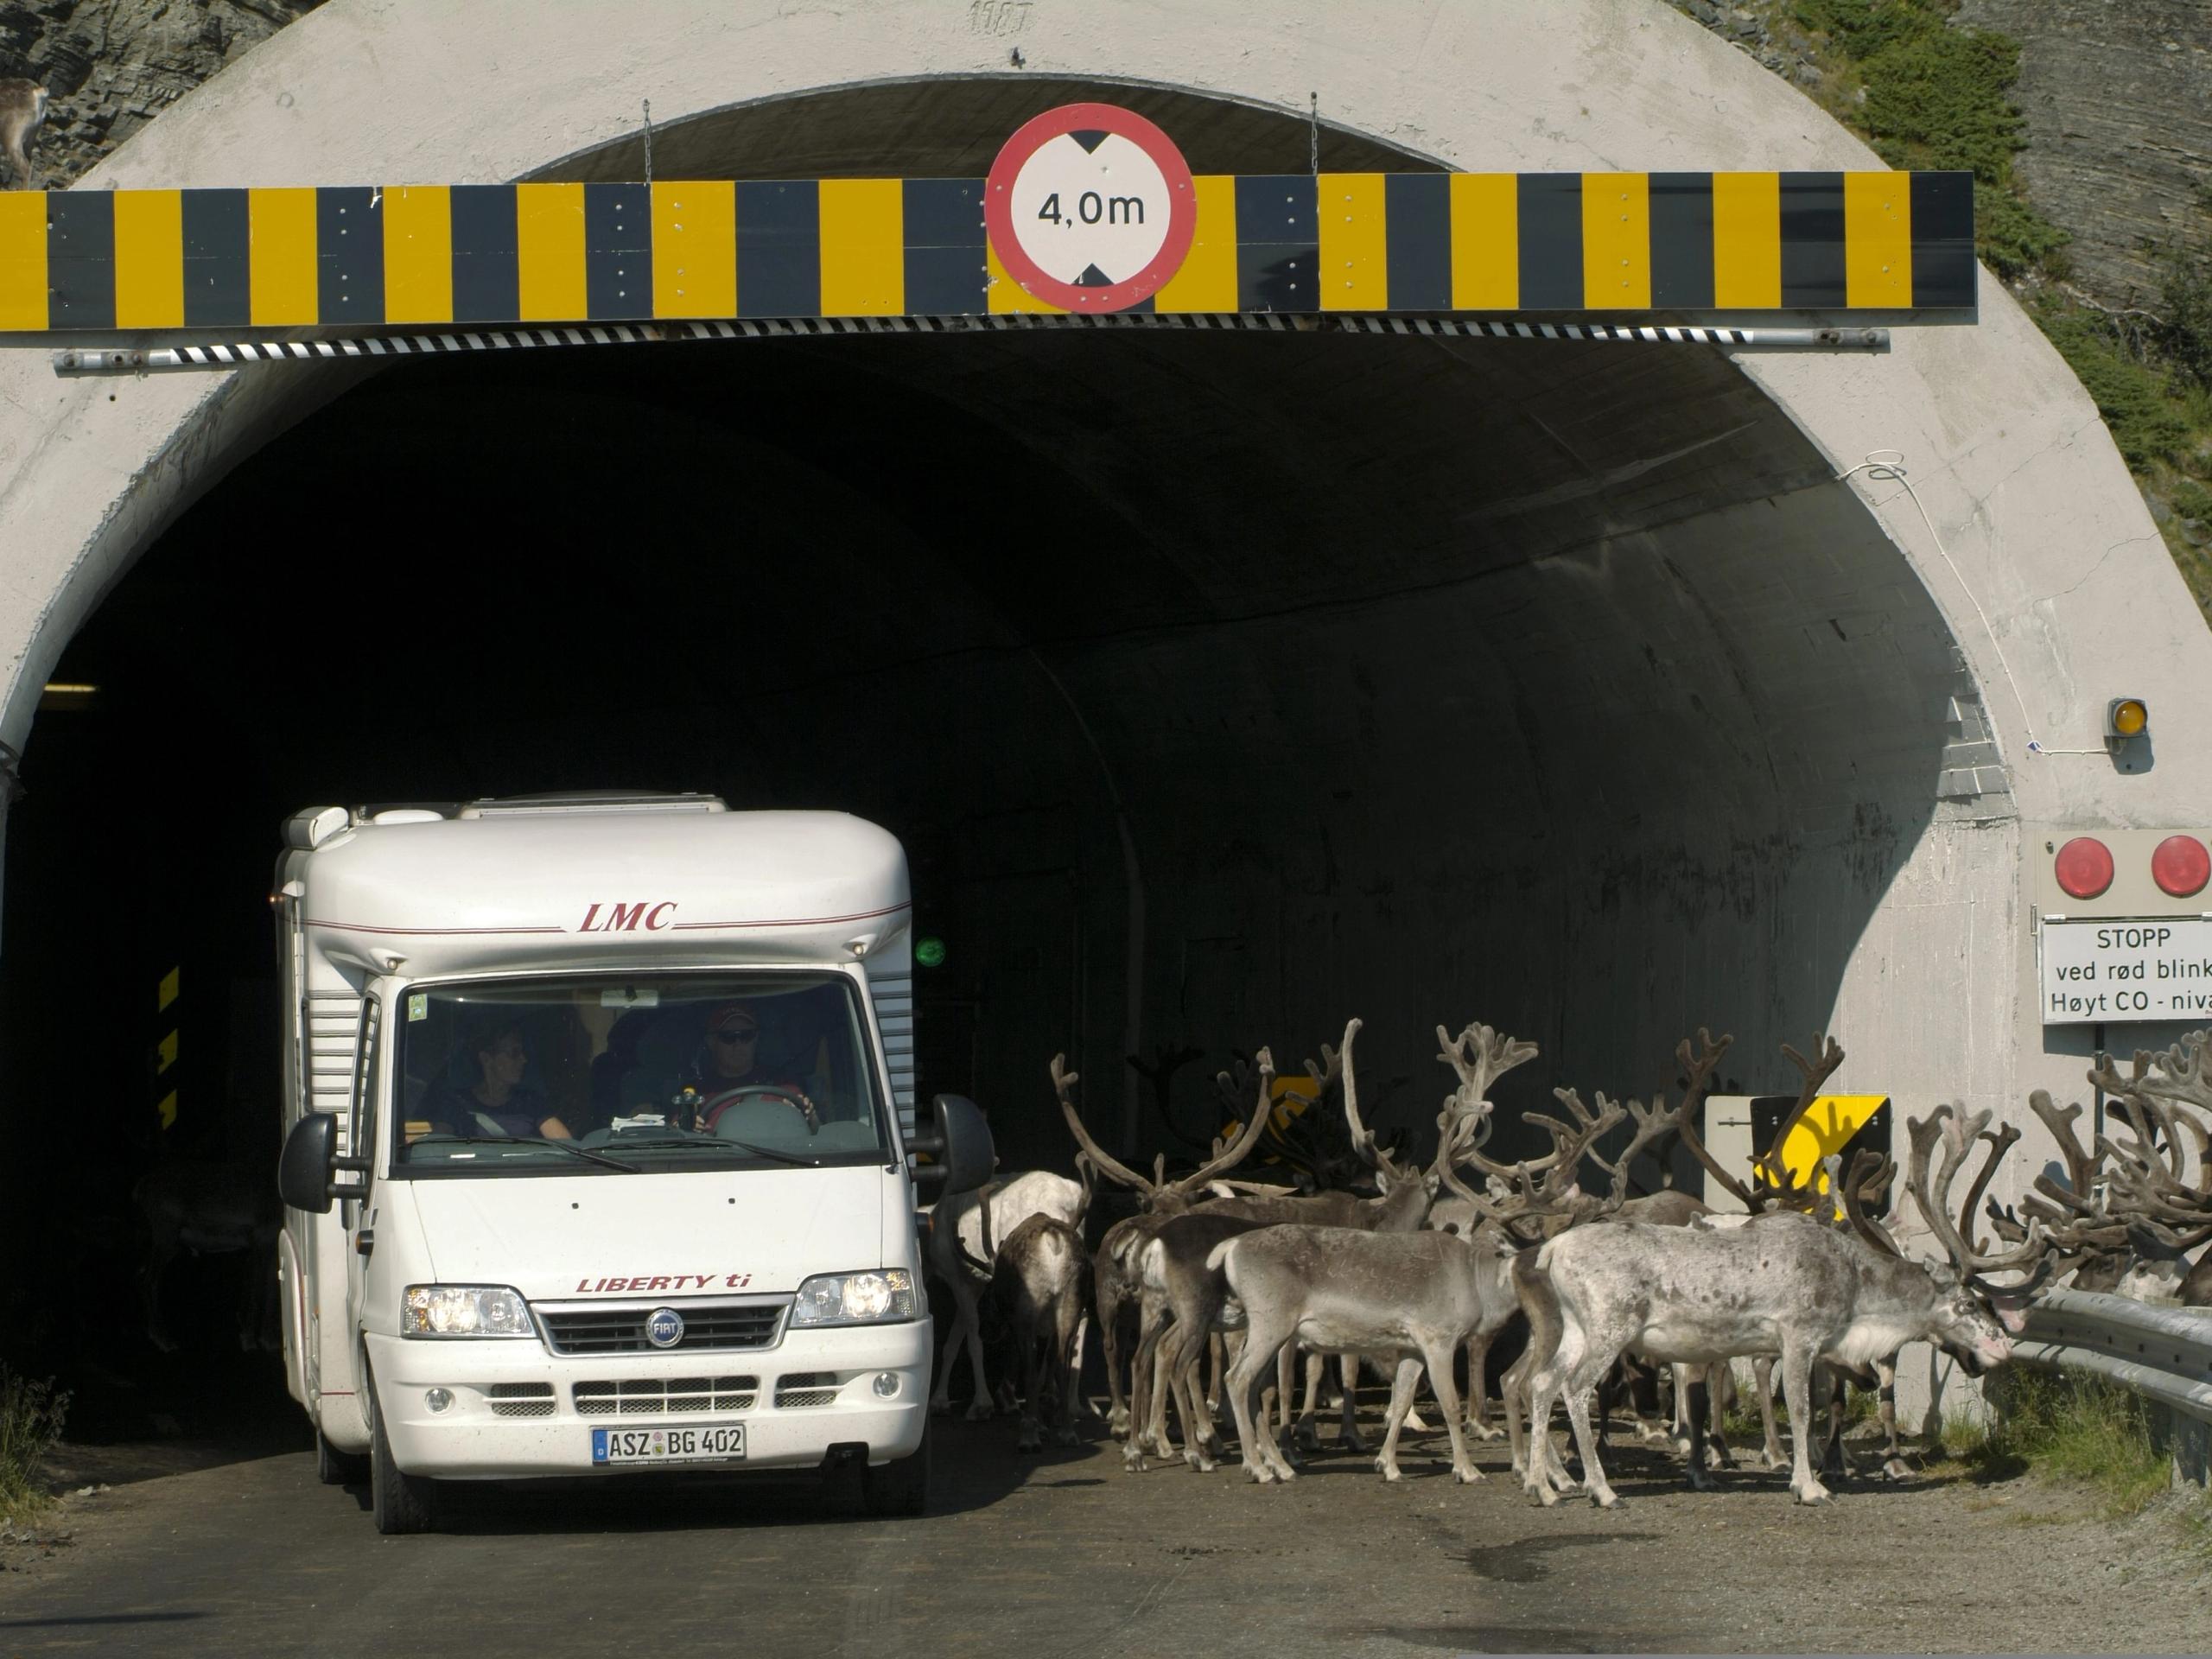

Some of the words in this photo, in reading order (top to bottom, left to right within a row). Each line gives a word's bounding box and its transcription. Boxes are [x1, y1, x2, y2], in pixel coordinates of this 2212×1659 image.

[1038, 191, 1145, 229] 4,0m
[577, 901, 678, 932] LMC
[2096, 928, 2171, 949] STOPP
[2056, 961, 2095, 981] ved
[2108, 960, 2145, 980] rød
[2157, 958, 2212, 979] blink
[2051, 993, 2107, 1017] Høyt
[2115, 991, 2149, 1011] CO
[575, 1274, 717, 1293] LIBERTY
[726, 1274, 753, 1287] ti
[653, 1322, 677, 1335] FIAT
[609, 1432, 651, 1457] ASZ
[668, 1431, 696, 1454] BG
[702, 1429, 741, 1452] 402
